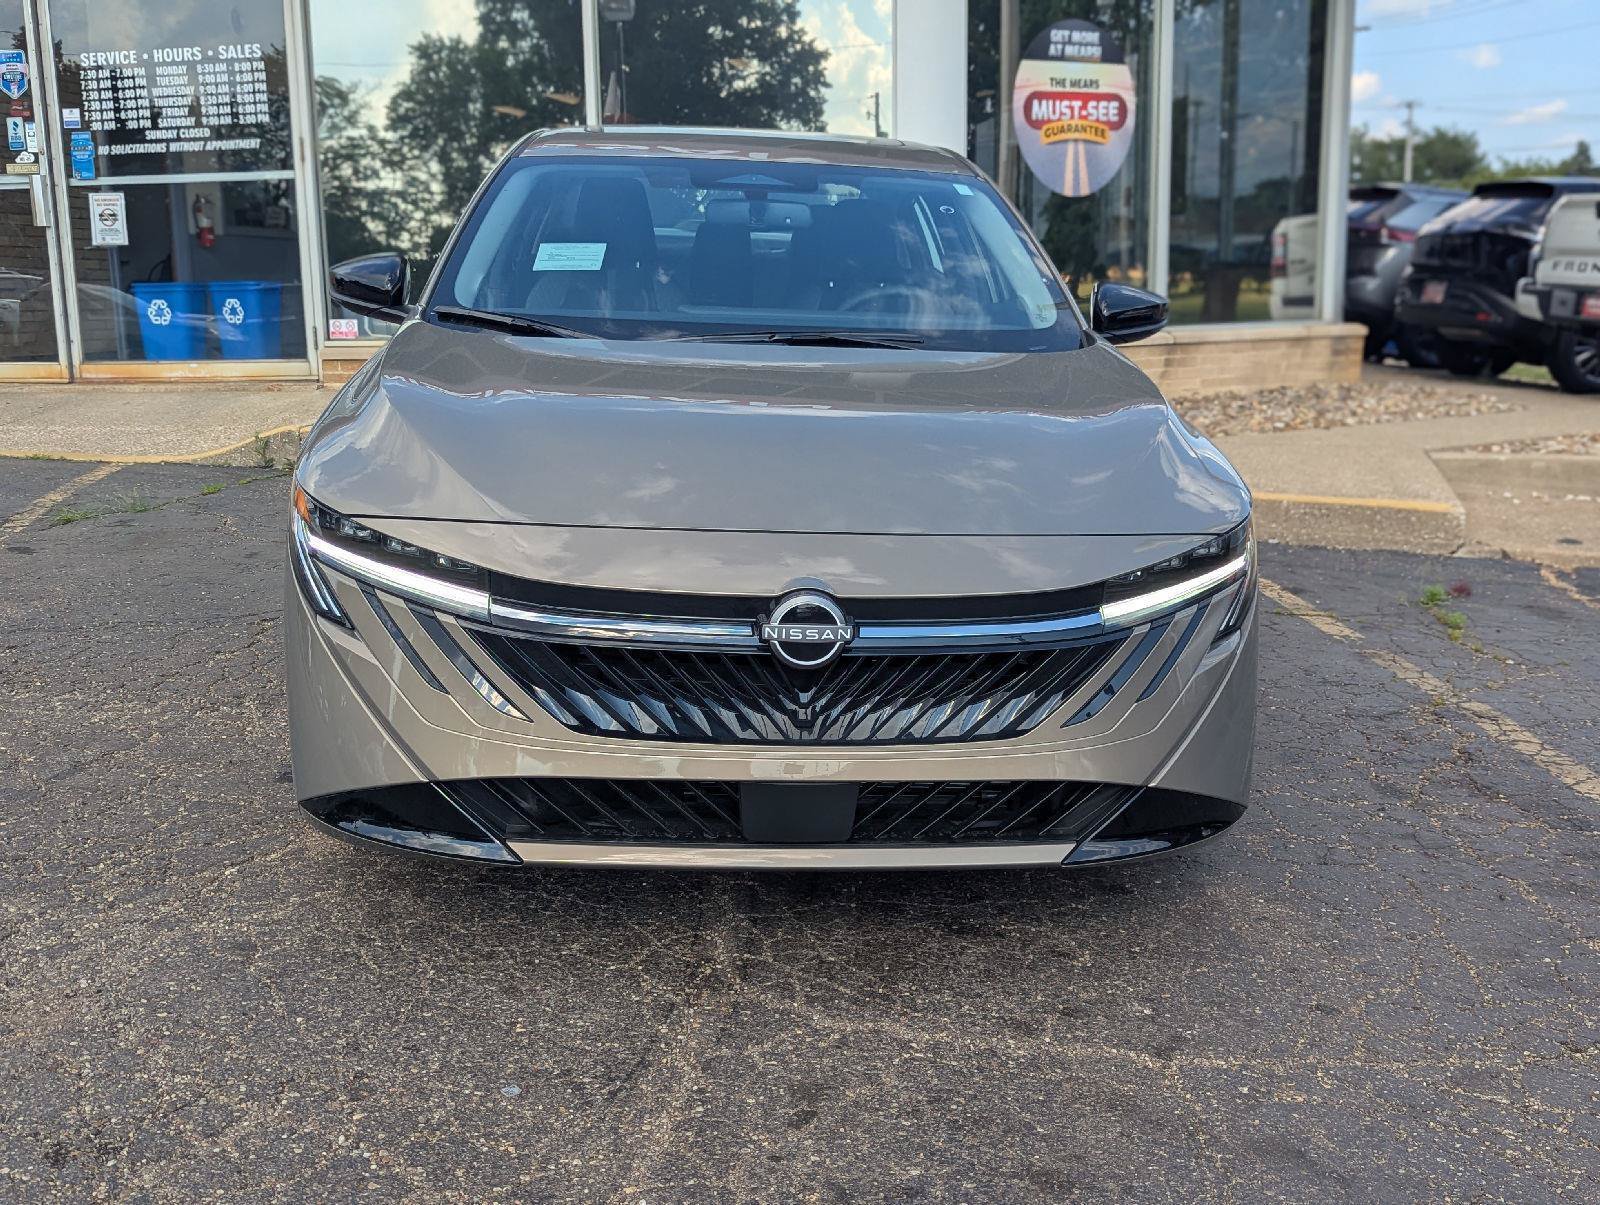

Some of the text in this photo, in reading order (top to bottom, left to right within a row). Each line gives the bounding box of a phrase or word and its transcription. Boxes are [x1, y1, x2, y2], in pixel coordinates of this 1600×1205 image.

[1050, 30, 1070, 42] GET
[80, 44, 262, 66] SERVICE HOURS SALES
[1048, 44, 1062, 56] AT
[156, 65, 187, 76] MONDAY
[196, 64, 214, 73] 8:30
[215, 63, 227, 72] AM
[253, 61, 265, 70] PM
[80, 70, 96, 79] 7:30
[98, 69, 110, 78] AM
[133, 67, 146, 76] PM
[216, 74, 228, 82] AM
[254, 72, 266, 81] PM
[80, 80, 97, 90] 7:30
[99, 79, 111, 88] AM
[117, 78, 134, 88] 6:00
[135, 78, 147, 87] PM
[156, 76, 188, 86] TUESDAY
[1049, 77, 1100, 89] THE MEARS
[152, 86, 195, 97] WEDNESDAY
[217, 84, 229, 93] AM
[255, 82, 267, 92] PM
[100, 90, 113, 99] AM
[118, 89, 135, 98] 6:00
[136, 88, 148, 98] PM
[218, 95, 230, 104] AM
[255, 93, 268, 102] PM
[102, 100, 114, 109] AM
[137, 99, 150, 108] PM
[154, 96, 192, 107] THURSDAY
[162, 106, 189, 117] FRIDAY
[219, 105, 231, 114] AM
[256, 103, 269, 113] PM
[1031, 98, 1120, 122] MUST-SEE
[102, 110, 115, 120] AM
[138, 109, 150, 118] PM
[220, 115, 232, 124] AM
[257, 113, 270, 123] PM
[103, 121, 116, 130] AM
[139, 119, 152, 128] PM
[158, 116, 196, 128] SATURDAY
[145, 128, 210, 140] SUNDAY CLOSED
[1044, 124, 1106, 139] GUARANTEE
[98, 145, 109, 156] NO
[111, 142, 167, 155] SOLICITATIONS
[170, 141, 204, 152] WITHOUT
[205, 138, 261, 150] APPOINTMENT
[764, 627, 851, 640] NISSAN
